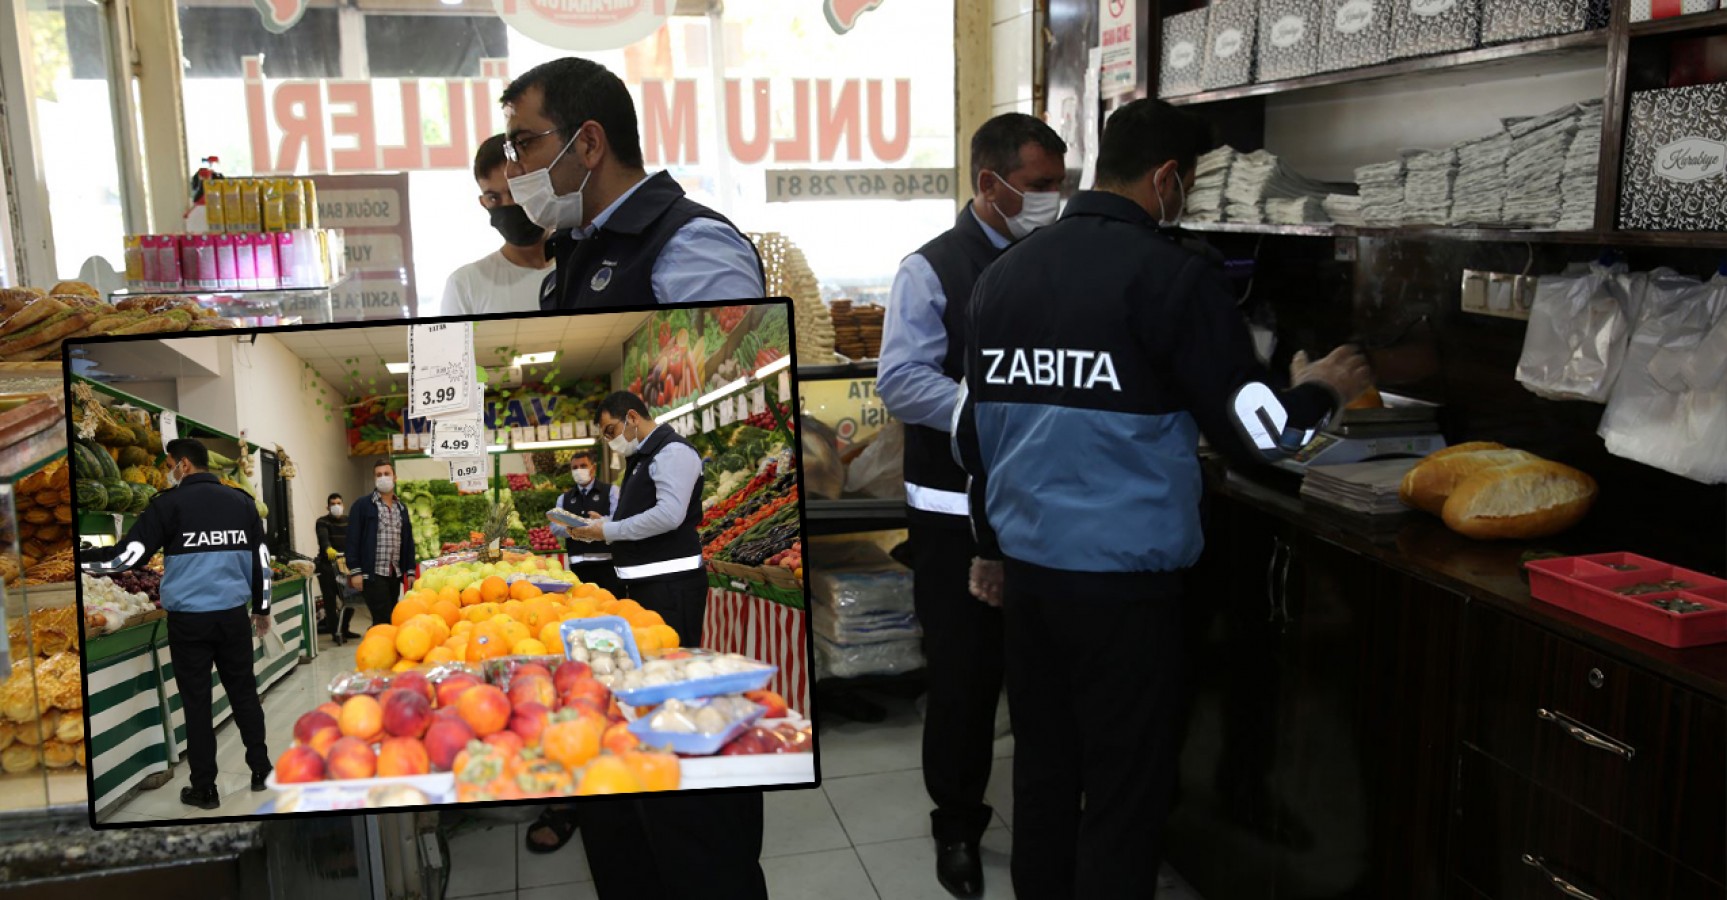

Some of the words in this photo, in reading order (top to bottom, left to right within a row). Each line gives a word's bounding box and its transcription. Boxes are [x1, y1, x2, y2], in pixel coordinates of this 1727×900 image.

[1662, 147, 1719, 171] Kurabiye
[982, 348, 1122, 393] ZABITA
[422, 387, 455, 405] 3.99
[402, 396, 559, 435] MNAV
[440, 440, 469, 450] 4.99
[457, 466, 478, 477] 0.99
[182, 529, 248, 548] ZABITA
